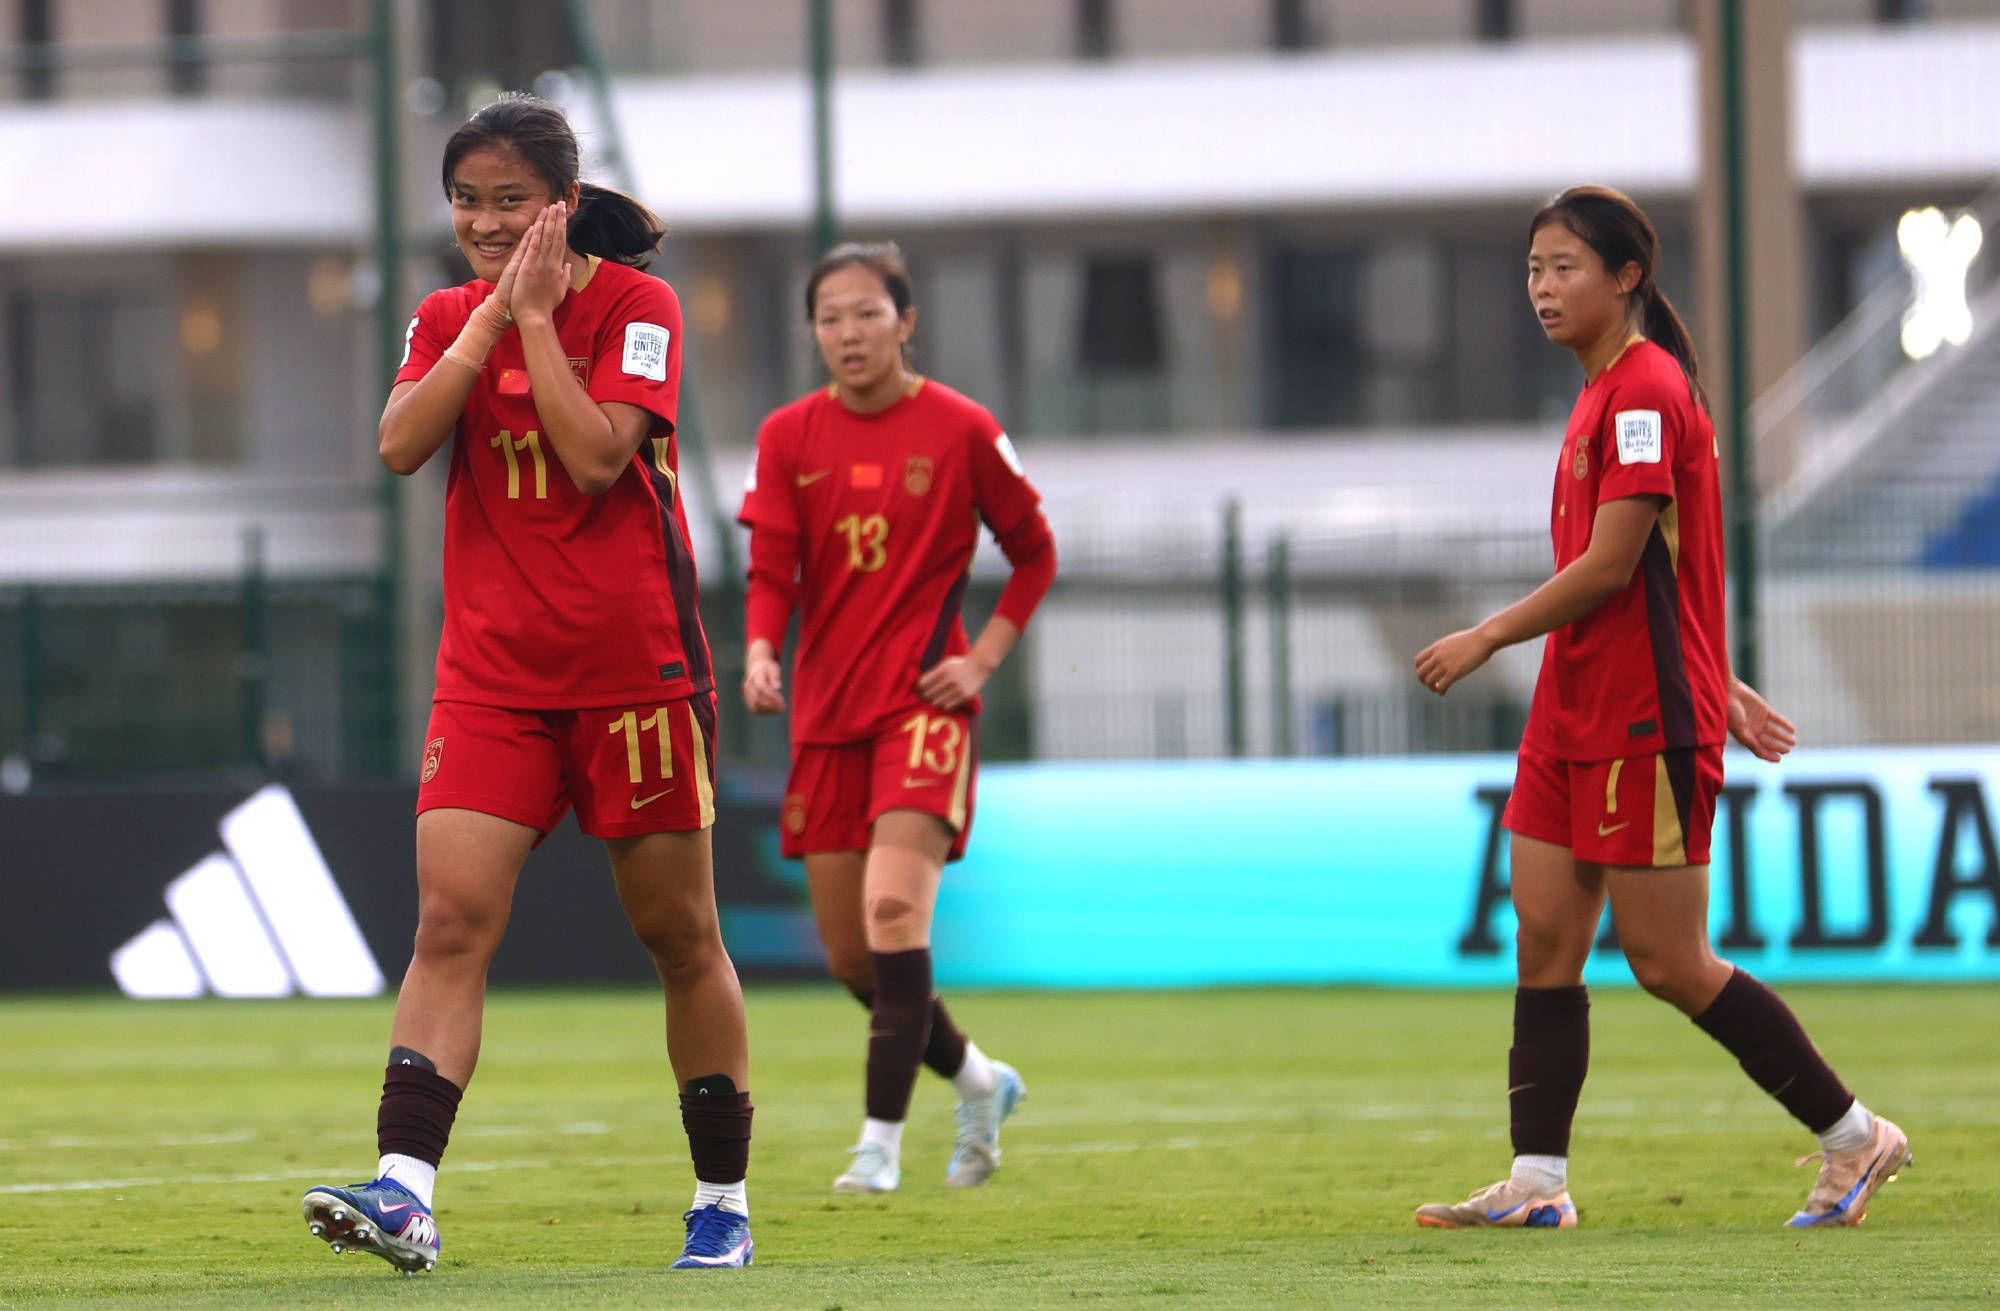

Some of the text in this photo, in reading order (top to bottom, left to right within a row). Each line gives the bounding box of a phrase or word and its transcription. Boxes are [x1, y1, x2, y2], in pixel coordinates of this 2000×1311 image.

[634, 340, 662, 356] UNITES
[635, 331, 663, 345] FOOTBALL
[490, 429, 547, 499] 11
[1624, 428, 1652, 441] UNITES
[836, 514, 889, 573] 13
[608, 707, 674, 784] 11
[902, 711, 961, 775] 13
[1458, 778, 2000, 957] AIDA
